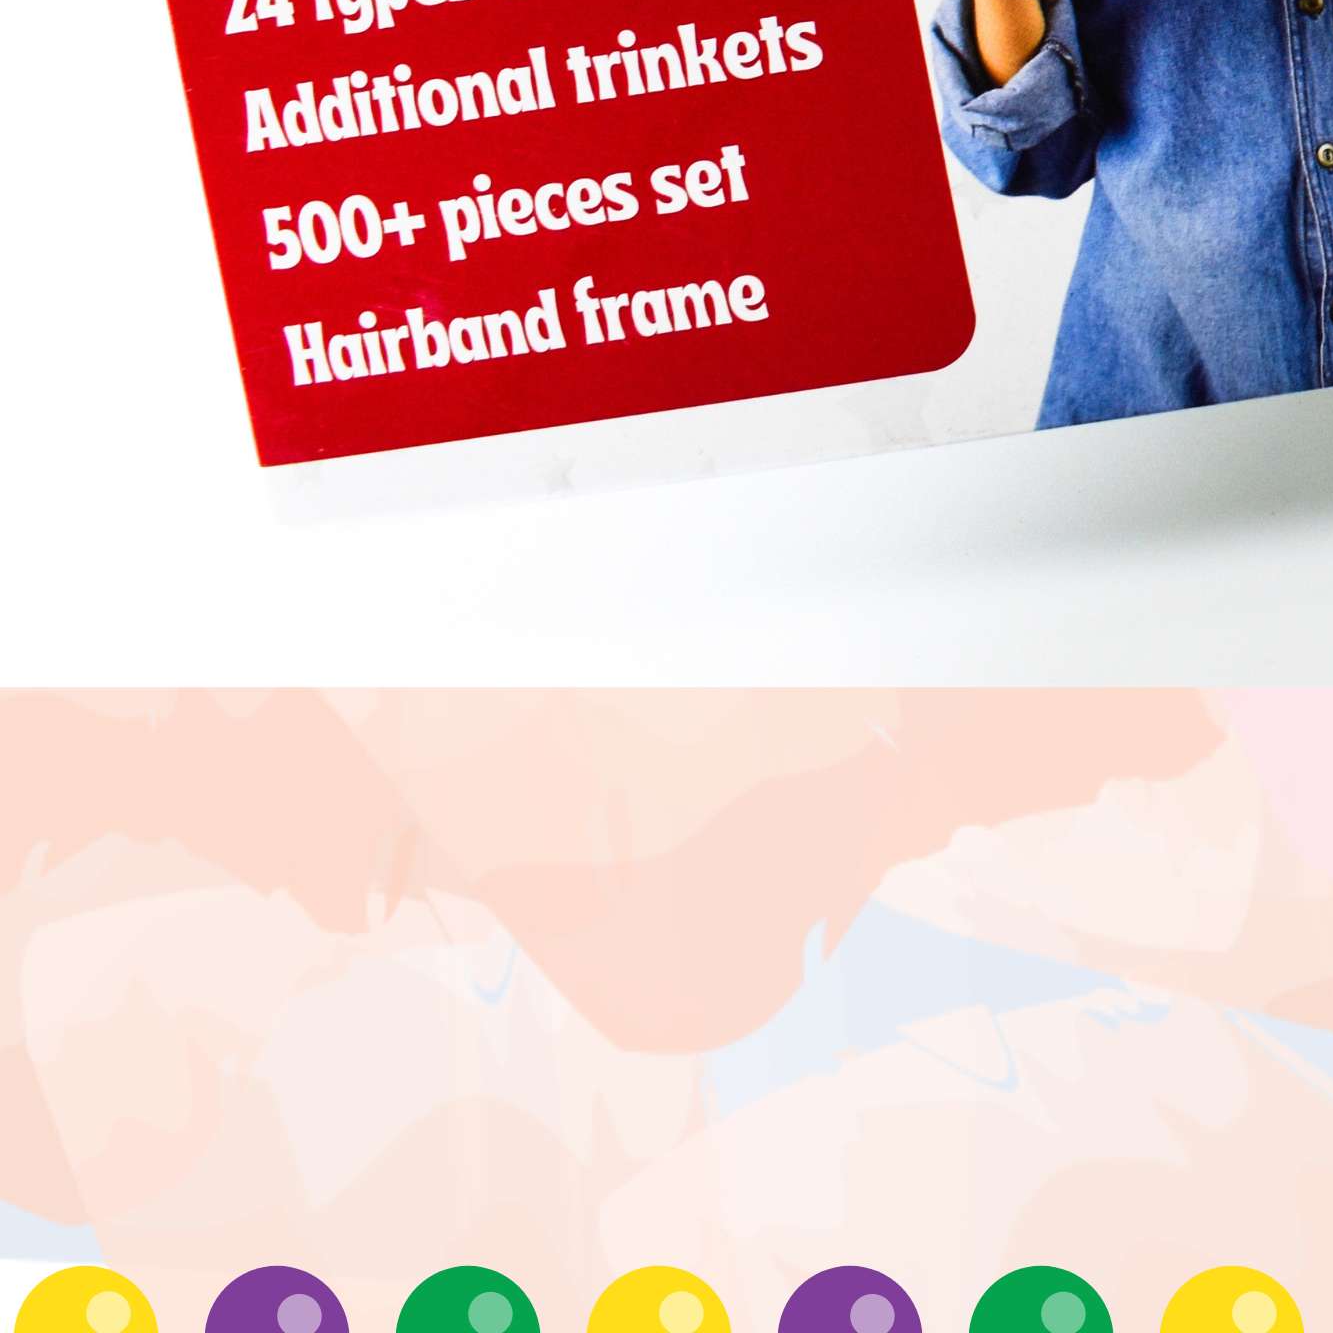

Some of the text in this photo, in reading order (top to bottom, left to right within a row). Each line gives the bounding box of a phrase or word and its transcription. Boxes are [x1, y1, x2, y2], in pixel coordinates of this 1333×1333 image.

[244, 16, 823, 152] Additional trinkets
[263, 145, 749, 270] 500+ pieces set
[284, 275, 769, 386] Hairband frame
